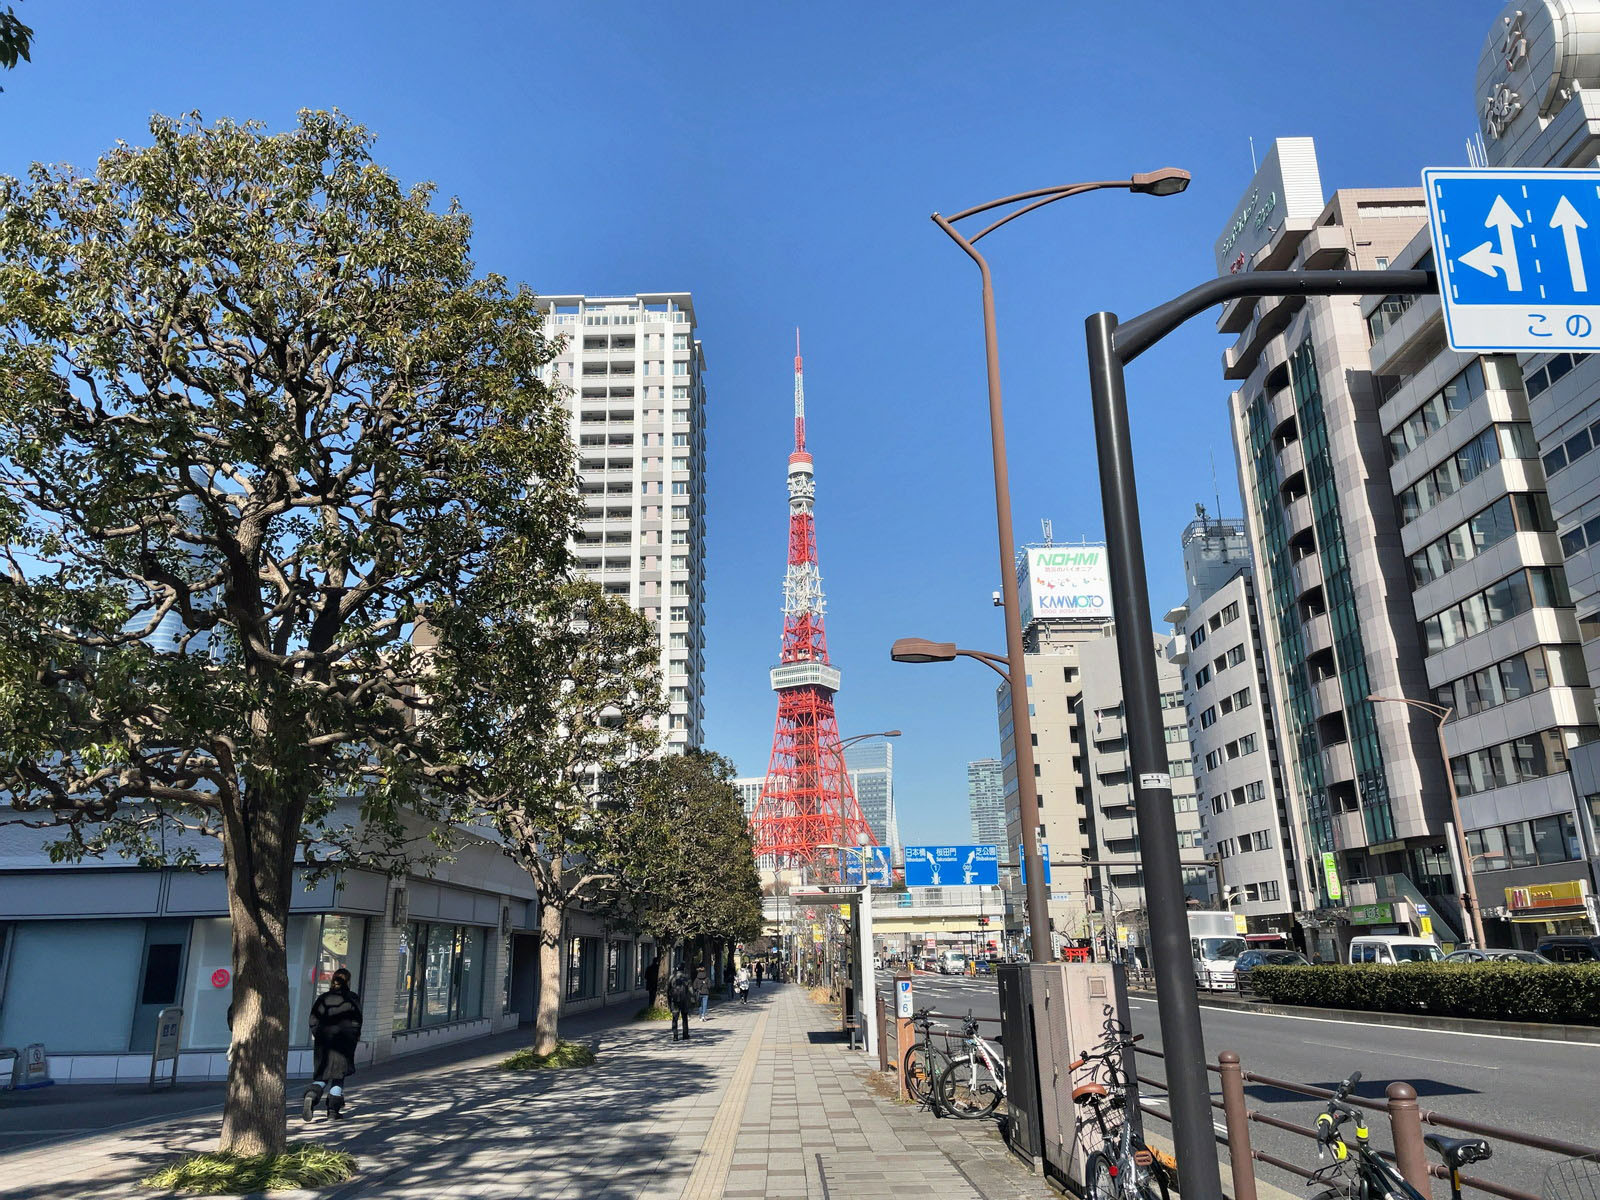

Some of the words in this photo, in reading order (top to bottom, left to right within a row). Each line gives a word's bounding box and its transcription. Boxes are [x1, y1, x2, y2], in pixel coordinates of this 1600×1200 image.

[1527, 314, 1592, 338] この
[1036, 553, 1099, 566] NOHMI
[905, 848, 926, 857] 日本橋
[936, 847, 957, 857] 桜田門
[975, 847, 996, 856] 芝公園
[902, 1003, 909, 1013] 6
